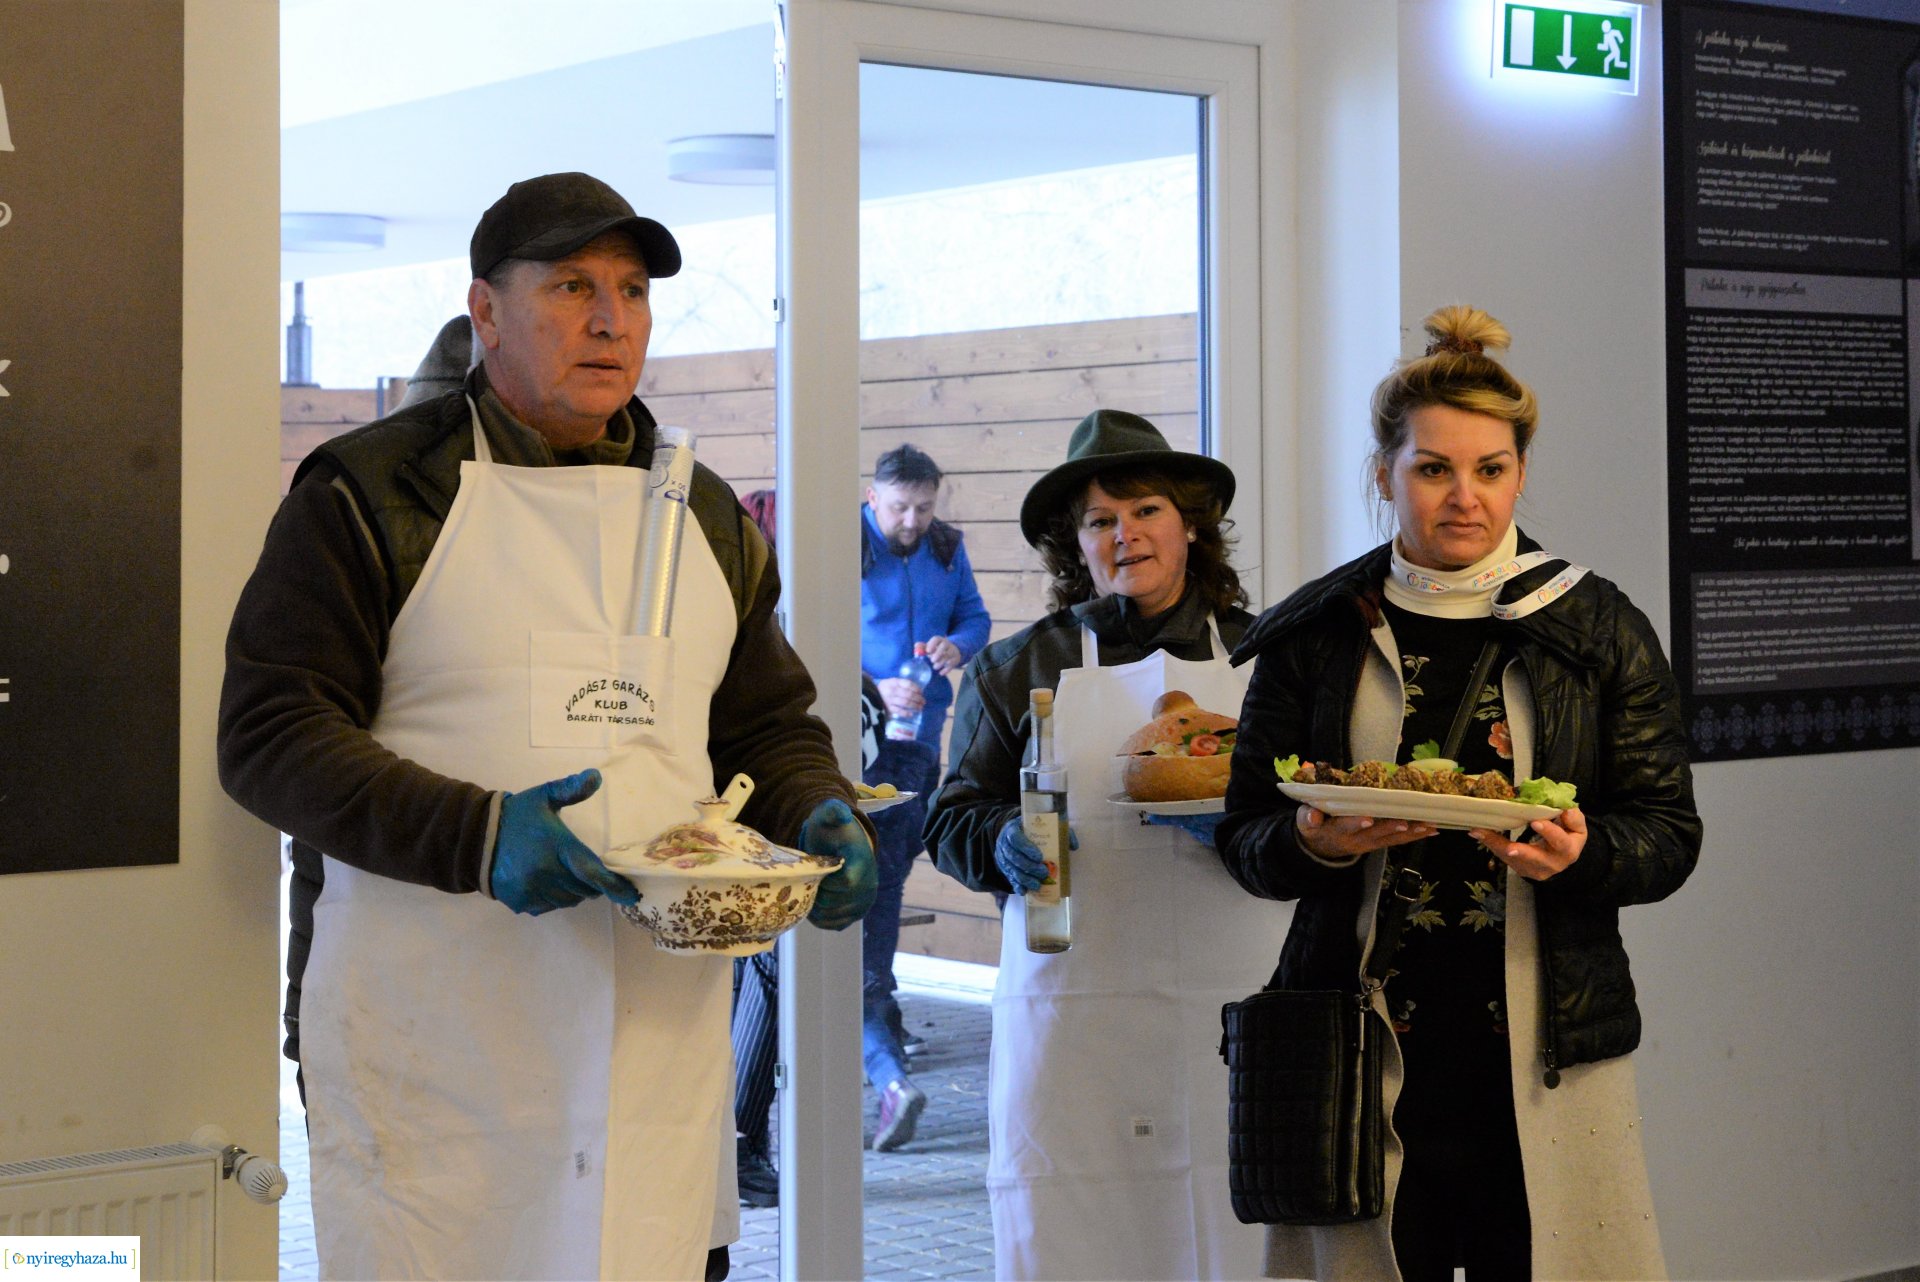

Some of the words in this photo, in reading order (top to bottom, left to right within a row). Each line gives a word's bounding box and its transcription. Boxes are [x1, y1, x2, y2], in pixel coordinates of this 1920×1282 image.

[565, 679, 607, 712] VADÁSZ
[594, 699, 628, 710] KLUB
[566, 713, 602, 723] BARÁTI
[607, 715, 655, 726] TÁRSASÁG
